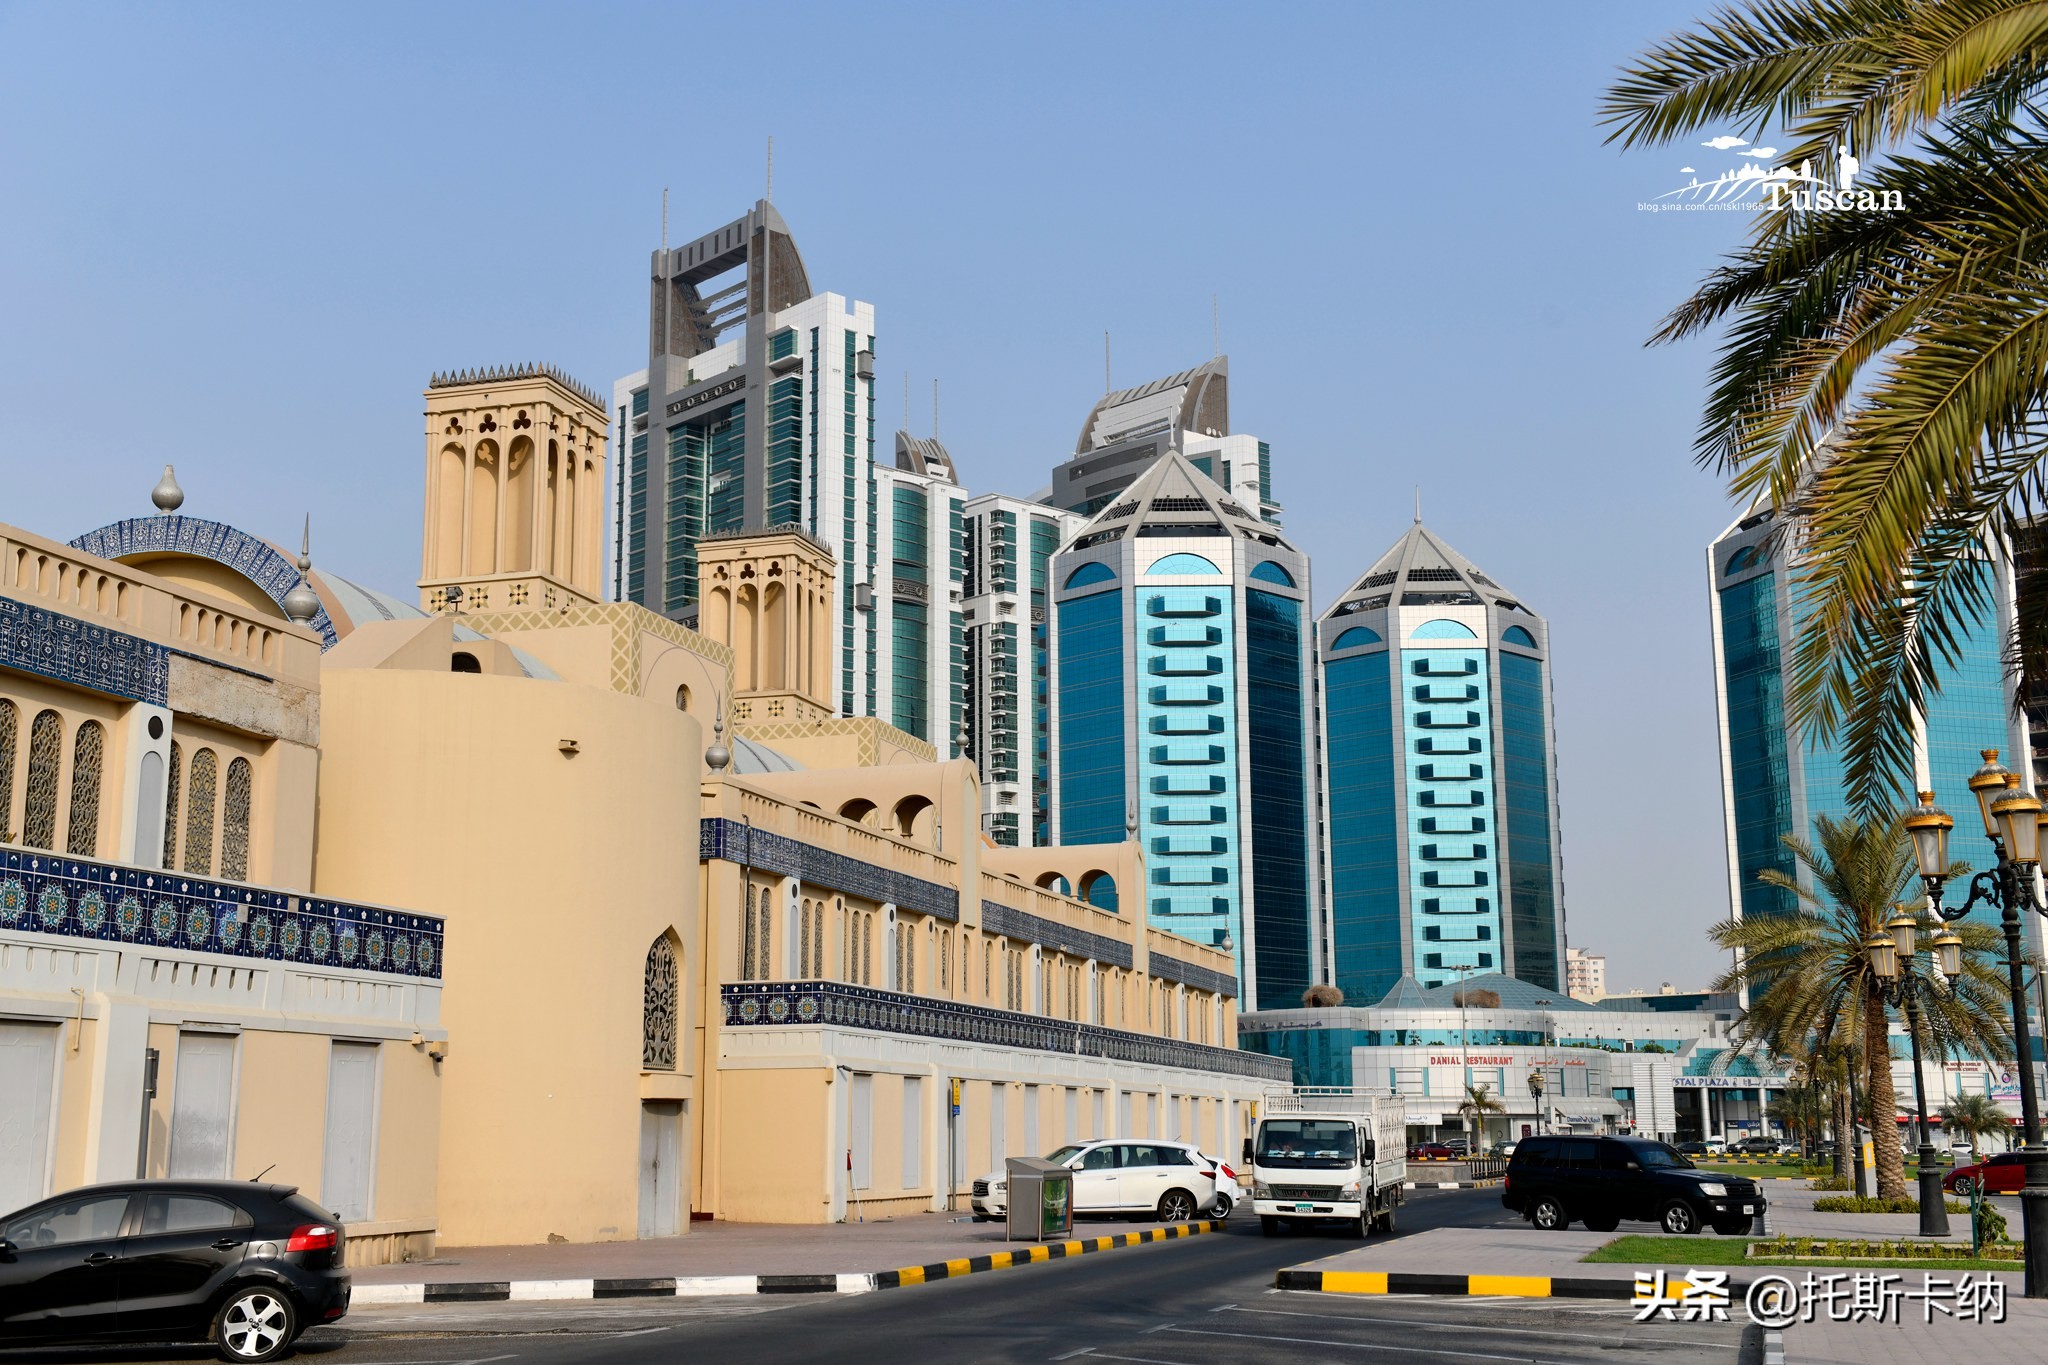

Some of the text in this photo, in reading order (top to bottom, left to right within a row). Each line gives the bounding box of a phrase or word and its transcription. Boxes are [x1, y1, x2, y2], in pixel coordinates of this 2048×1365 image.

[1430, 1056, 1513, 1065] DANIAL RESTAURANT
[1674, 1077, 1729, 1087] STAL PLAZA
